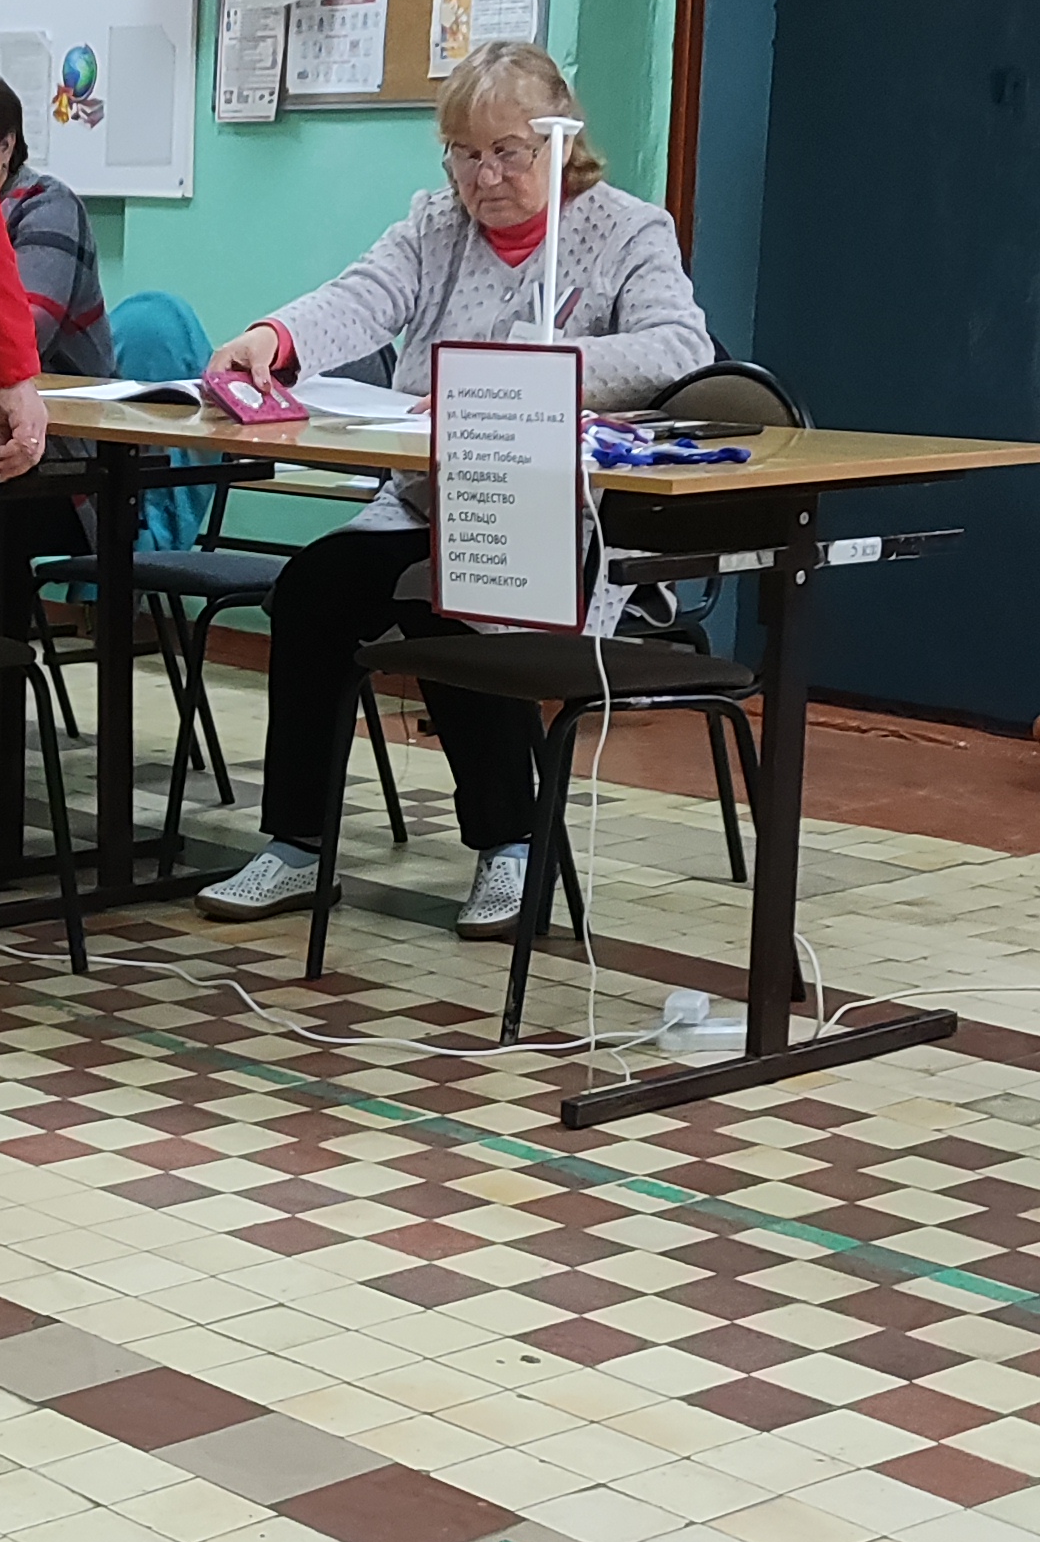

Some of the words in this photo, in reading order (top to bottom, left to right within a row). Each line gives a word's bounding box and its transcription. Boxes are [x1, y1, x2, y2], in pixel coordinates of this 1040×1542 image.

[458, 387, 523, 400] НИКОЛЬСКОЕ
[460, 409, 518, 422] Центральная
[447, 451, 459, 461] ул.
[462, 449, 474, 461] 30
[475, 452, 492, 462] лет
[494, 451, 532, 465] Победы
[458, 470, 508, 483] ПОДВЯЗЬЕ
[456, 490, 516, 505] РОЖДЕСТВО
[459, 511, 497, 525] СЕЛЬЦО
[460, 531, 508, 546] ШАСТОВО
[448, 551, 466, 562] СНТ
[468, 551, 508, 566] ЛЕСНОЙ
[450, 571, 466, 583] СНТ
[469, 573, 528, 588] ПРОЖЕКТОР
